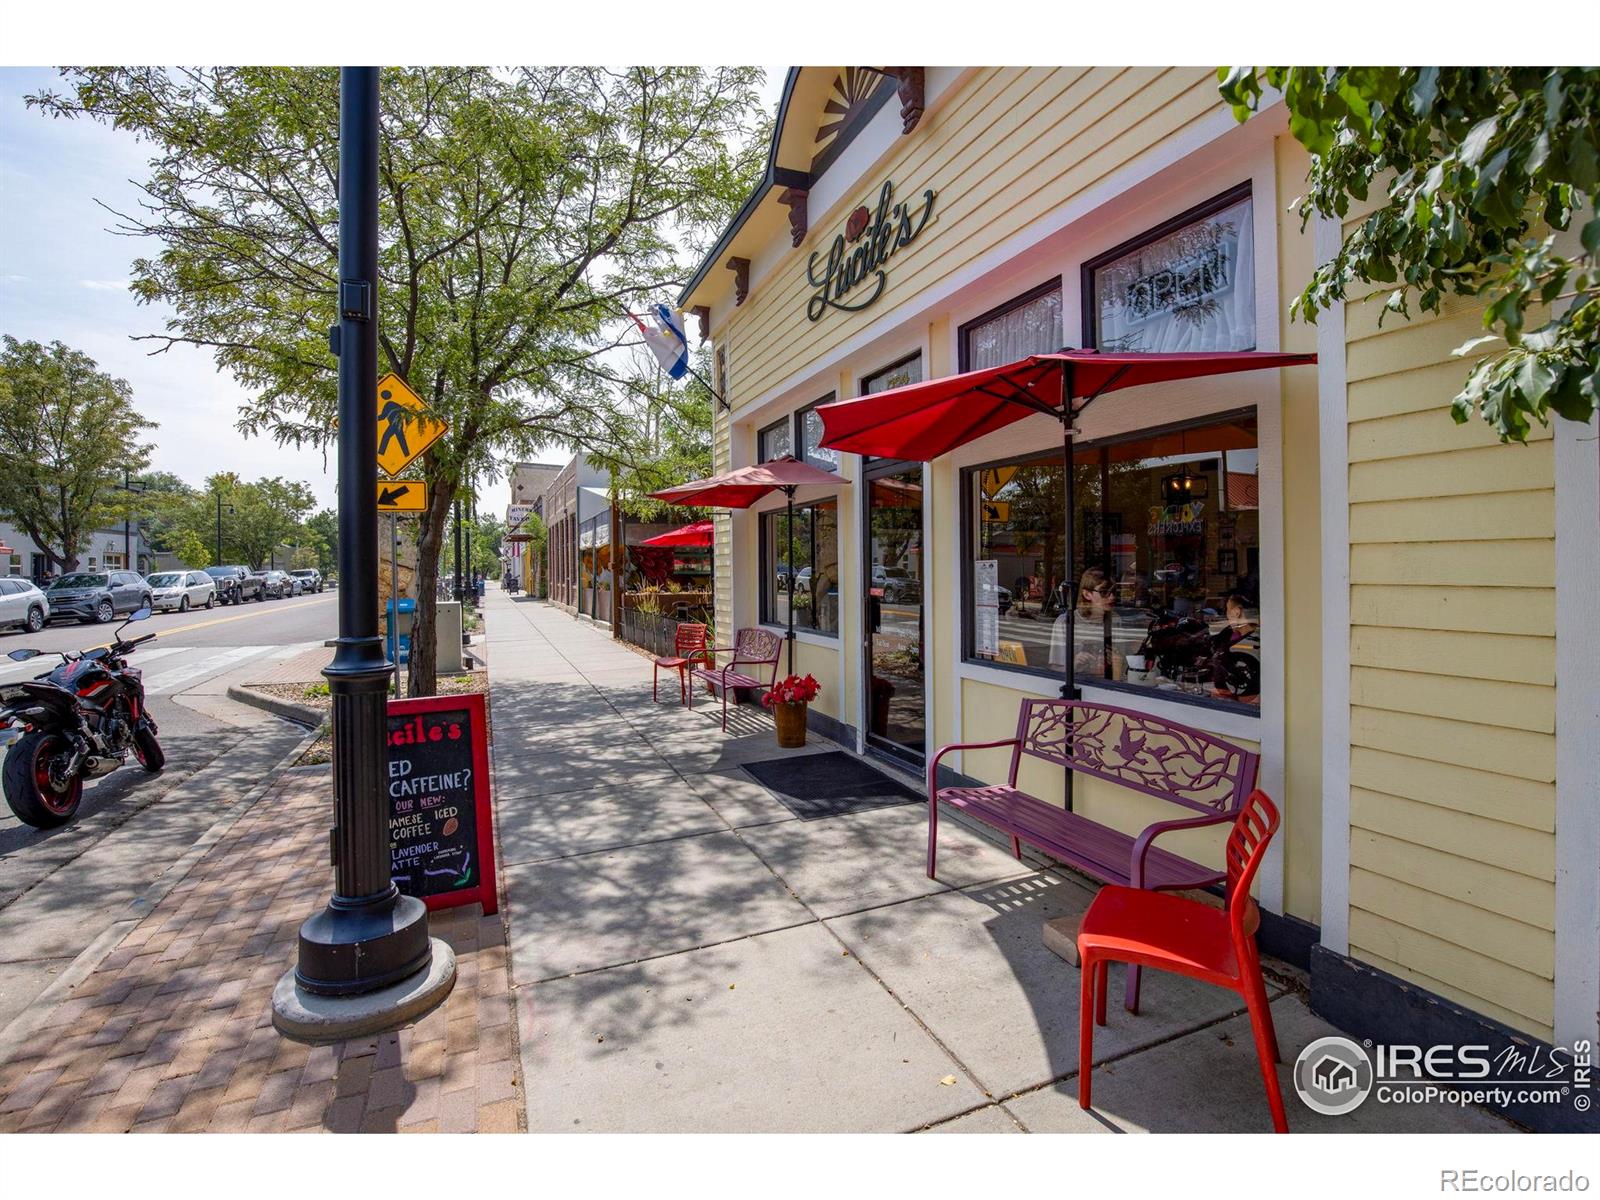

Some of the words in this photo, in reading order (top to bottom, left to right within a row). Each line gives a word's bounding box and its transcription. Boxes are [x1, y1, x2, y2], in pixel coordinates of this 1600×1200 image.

[807, 180, 934, 321] Lucile's
[387, 715, 462, 746] cile's
[389, 760, 412, 777] ED
[389, 768, 471, 797] CAFFEINE?
[395, 800, 413, 810] OUR
[420, 796, 446, 808] NEW:
[434, 806, 458, 819] ICED
[393, 823, 432, 840] COFFEE
[391, 841, 439, 860] LAVENDER
[391, 857, 420, 871] ATTE
